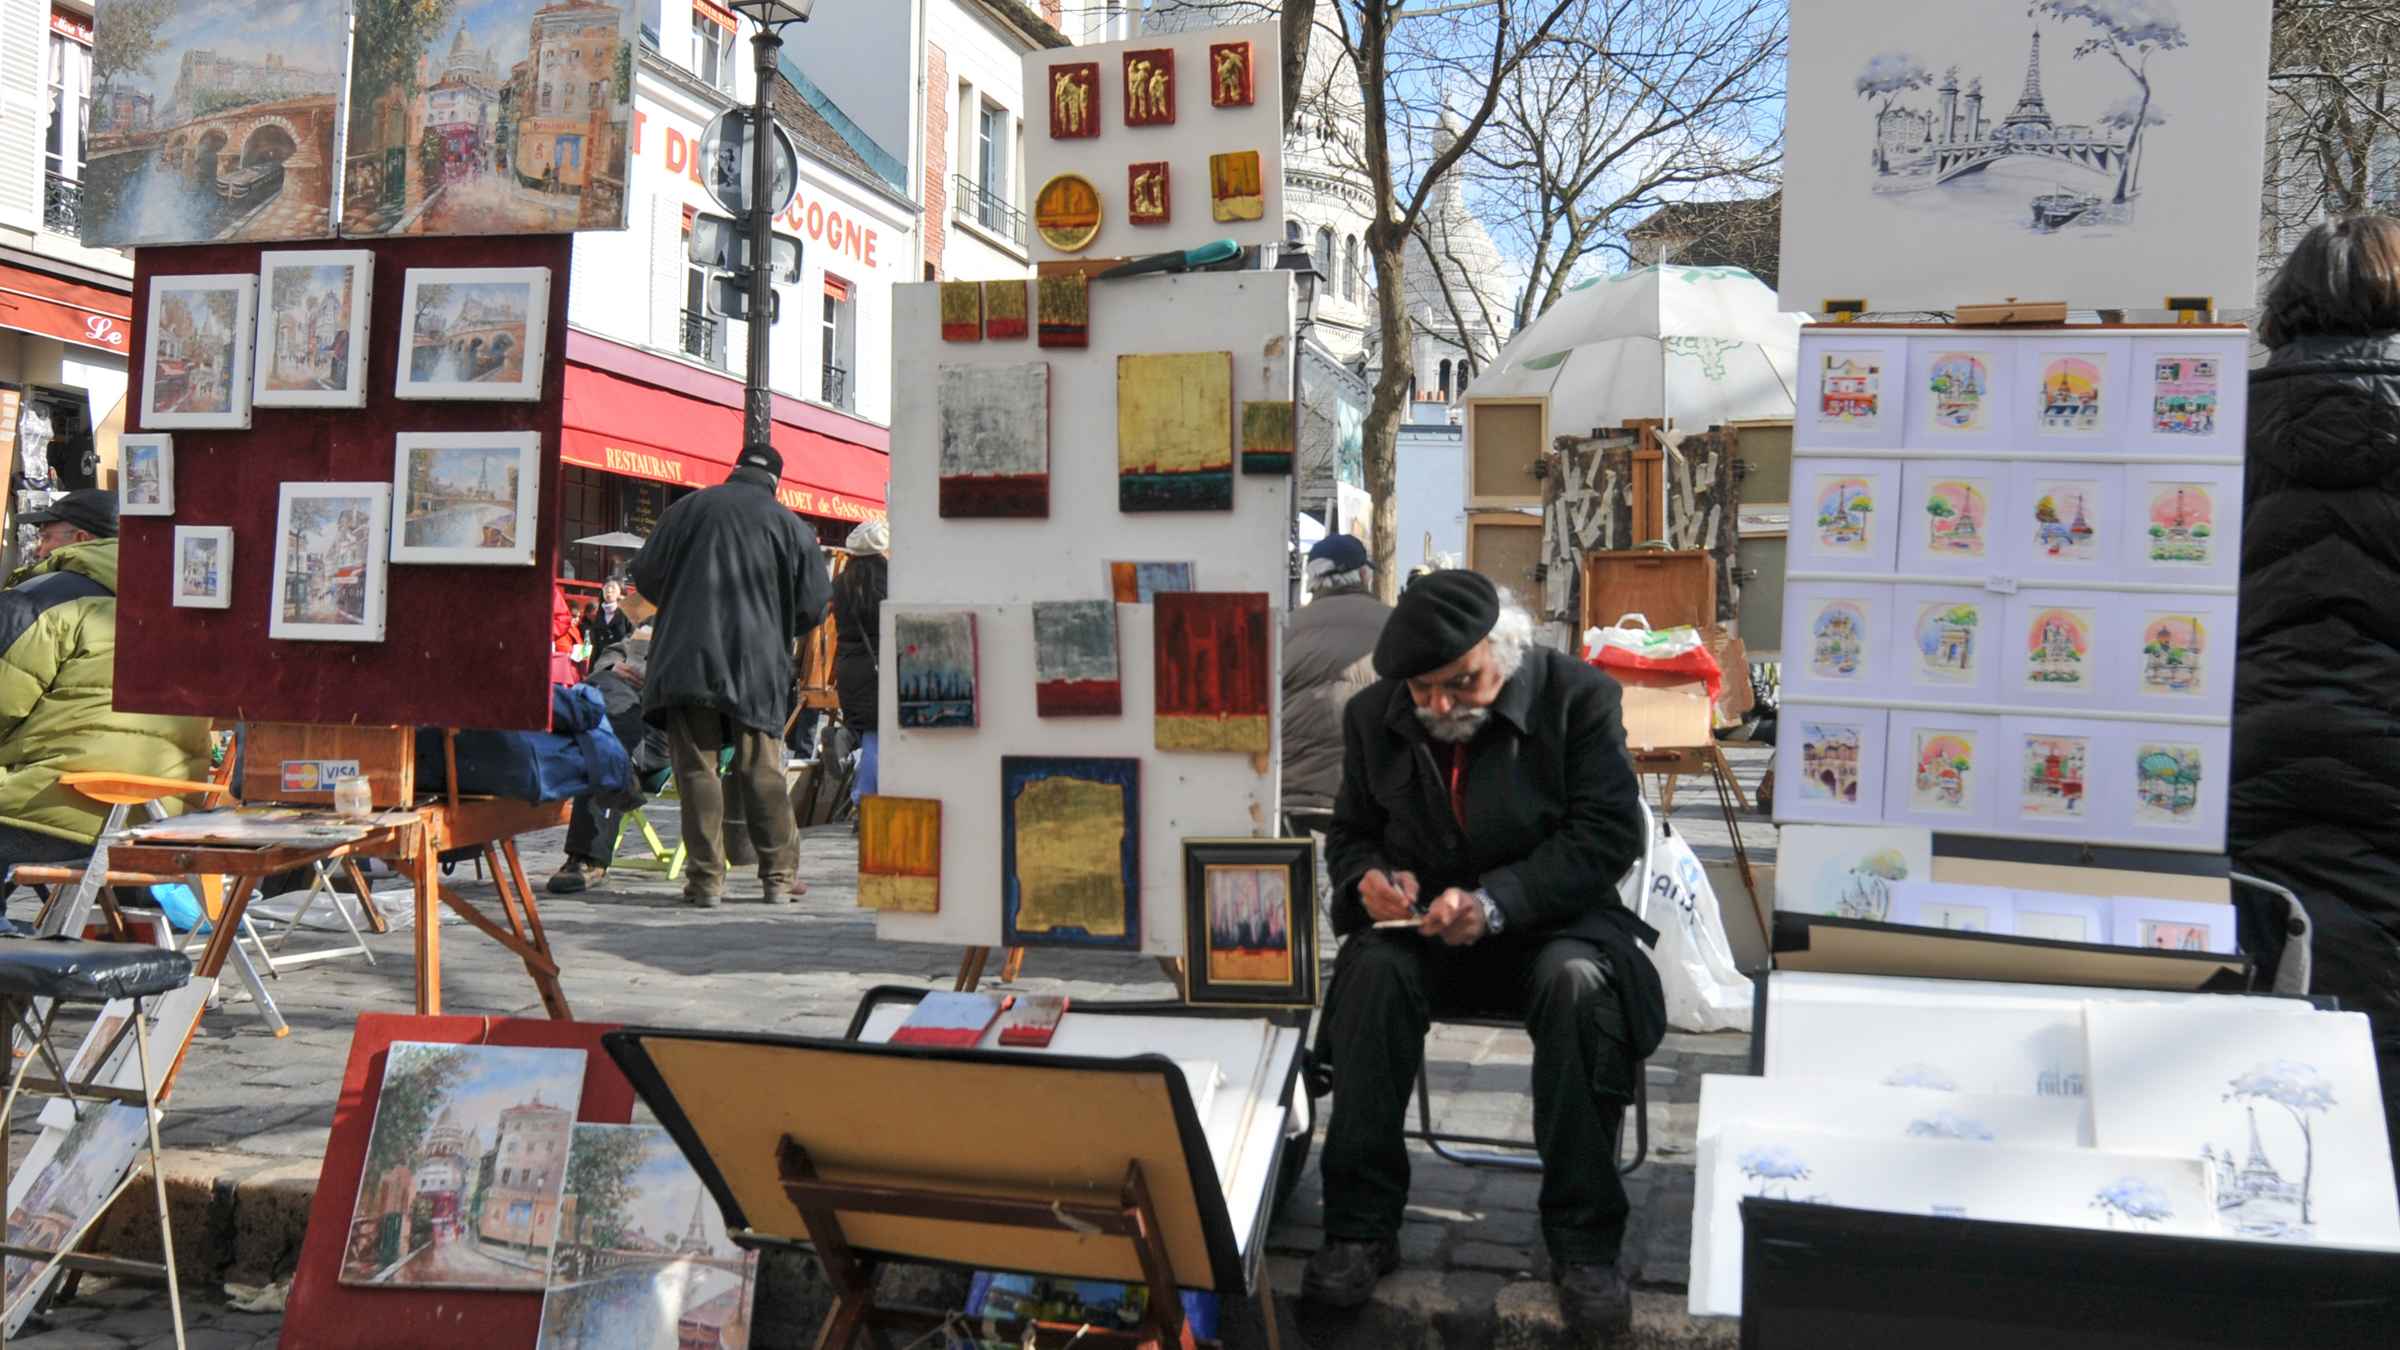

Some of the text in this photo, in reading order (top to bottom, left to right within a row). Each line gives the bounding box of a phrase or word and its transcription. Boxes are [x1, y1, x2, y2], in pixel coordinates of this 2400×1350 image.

[773, 192, 878, 268] COGNE
[86, 316, 122, 344] Le
[605, 448, 682, 481] RESTAURANT
[326, 766, 356, 779] VISA
